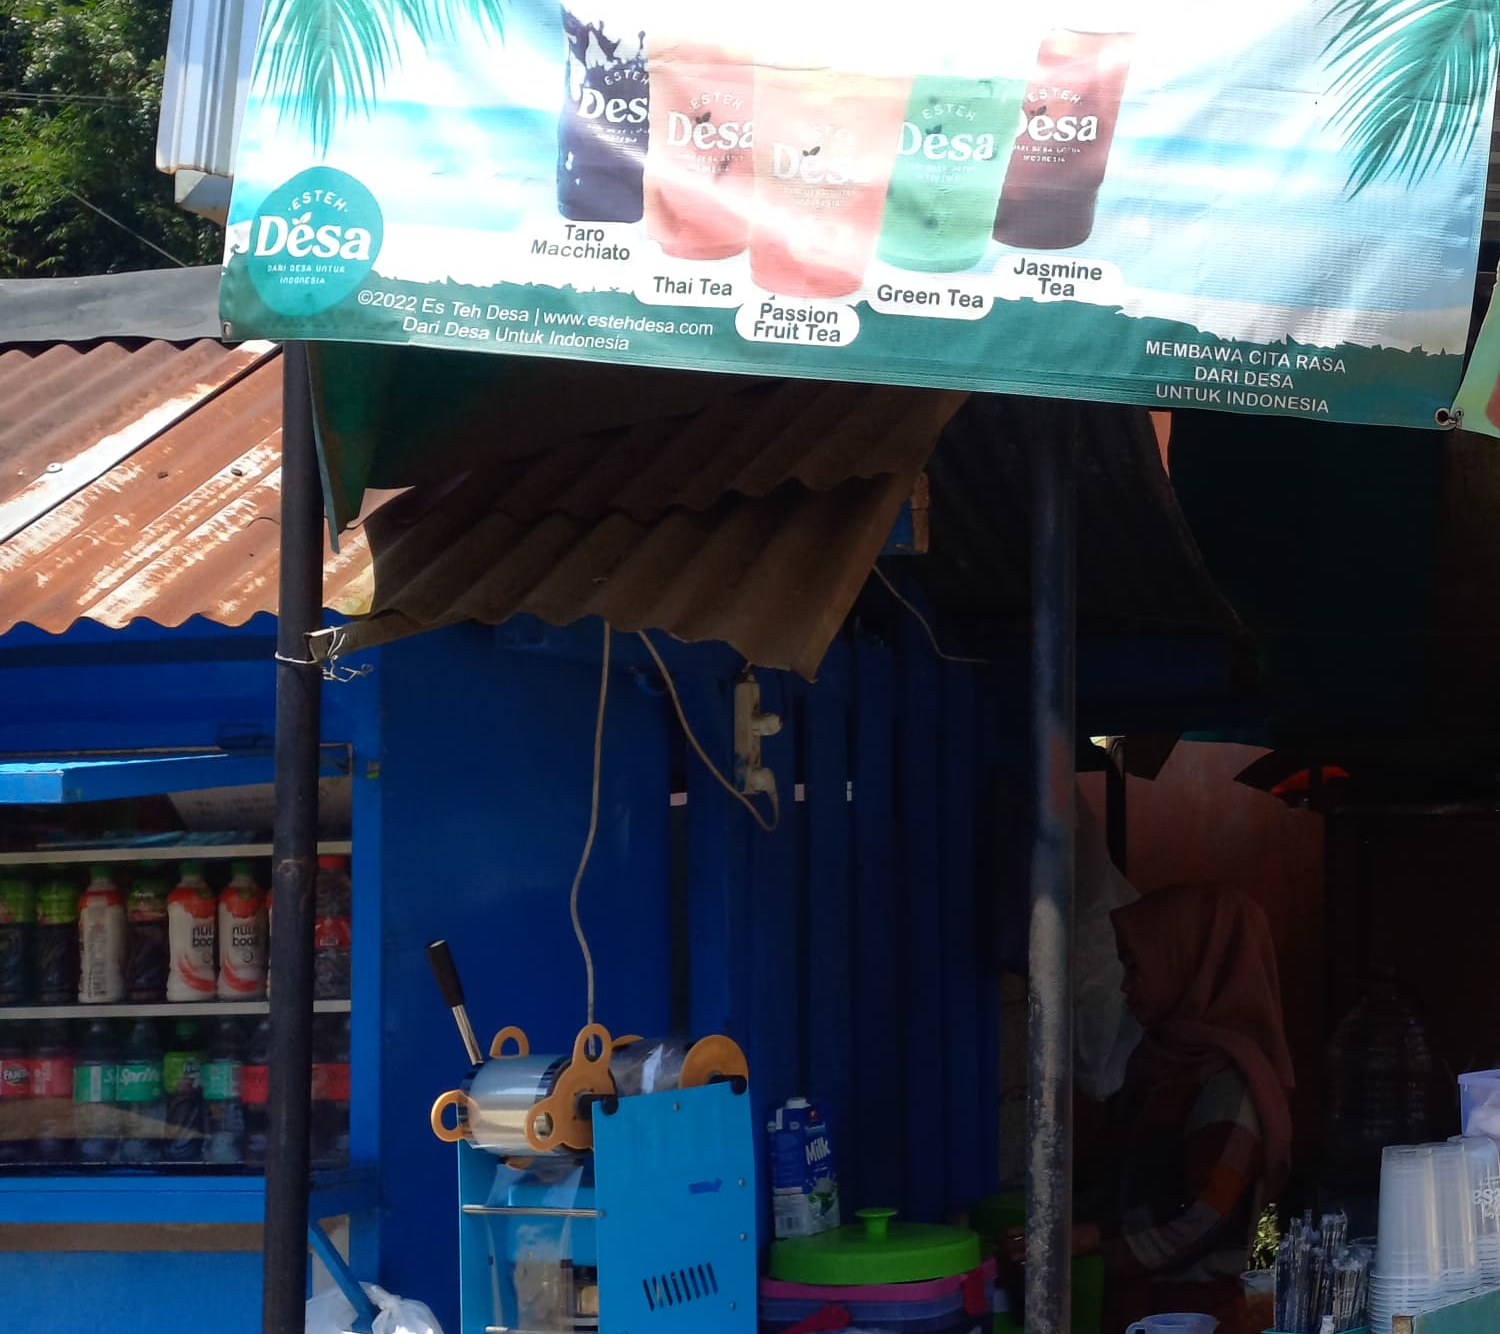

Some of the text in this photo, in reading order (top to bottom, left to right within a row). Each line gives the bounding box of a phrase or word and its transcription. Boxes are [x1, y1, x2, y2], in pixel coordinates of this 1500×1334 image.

[576, 87, 650, 123] Des
[897, 121, 994, 161] Desa
[254, 214, 371, 260] Desa
[564, 224, 605, 243] Taro
[530, 239, 631, 262] Macchiato
[1013, 257, 1103, 281] Jasmine
[652, 275, 733, 297] Thai Tea
[876, 284, 984, 308] Green Tea
[1038, 277, 1075, 297] Tea
[421, 297, 446, 315] Es
[451, 301, 481, 319] Teh
[486, 304, 530, 323] Desa
[543, 310, 714, 337] www.estehdesa.com
[759, 302, 838, 325] Passion
[402, 316, 630, 352] Dari Desa Untuk Indonesia
[753, 320, 841, 343] Fruit Tea
[1146, 340, 1346, 375] MEMBAWA CITA RASA
[1194, 366, 1295, 390] DARI DESA
[1156, 383, 1329, 414] UNTUK INDONESIA
[805, 1137, 830, 1165] Milk
